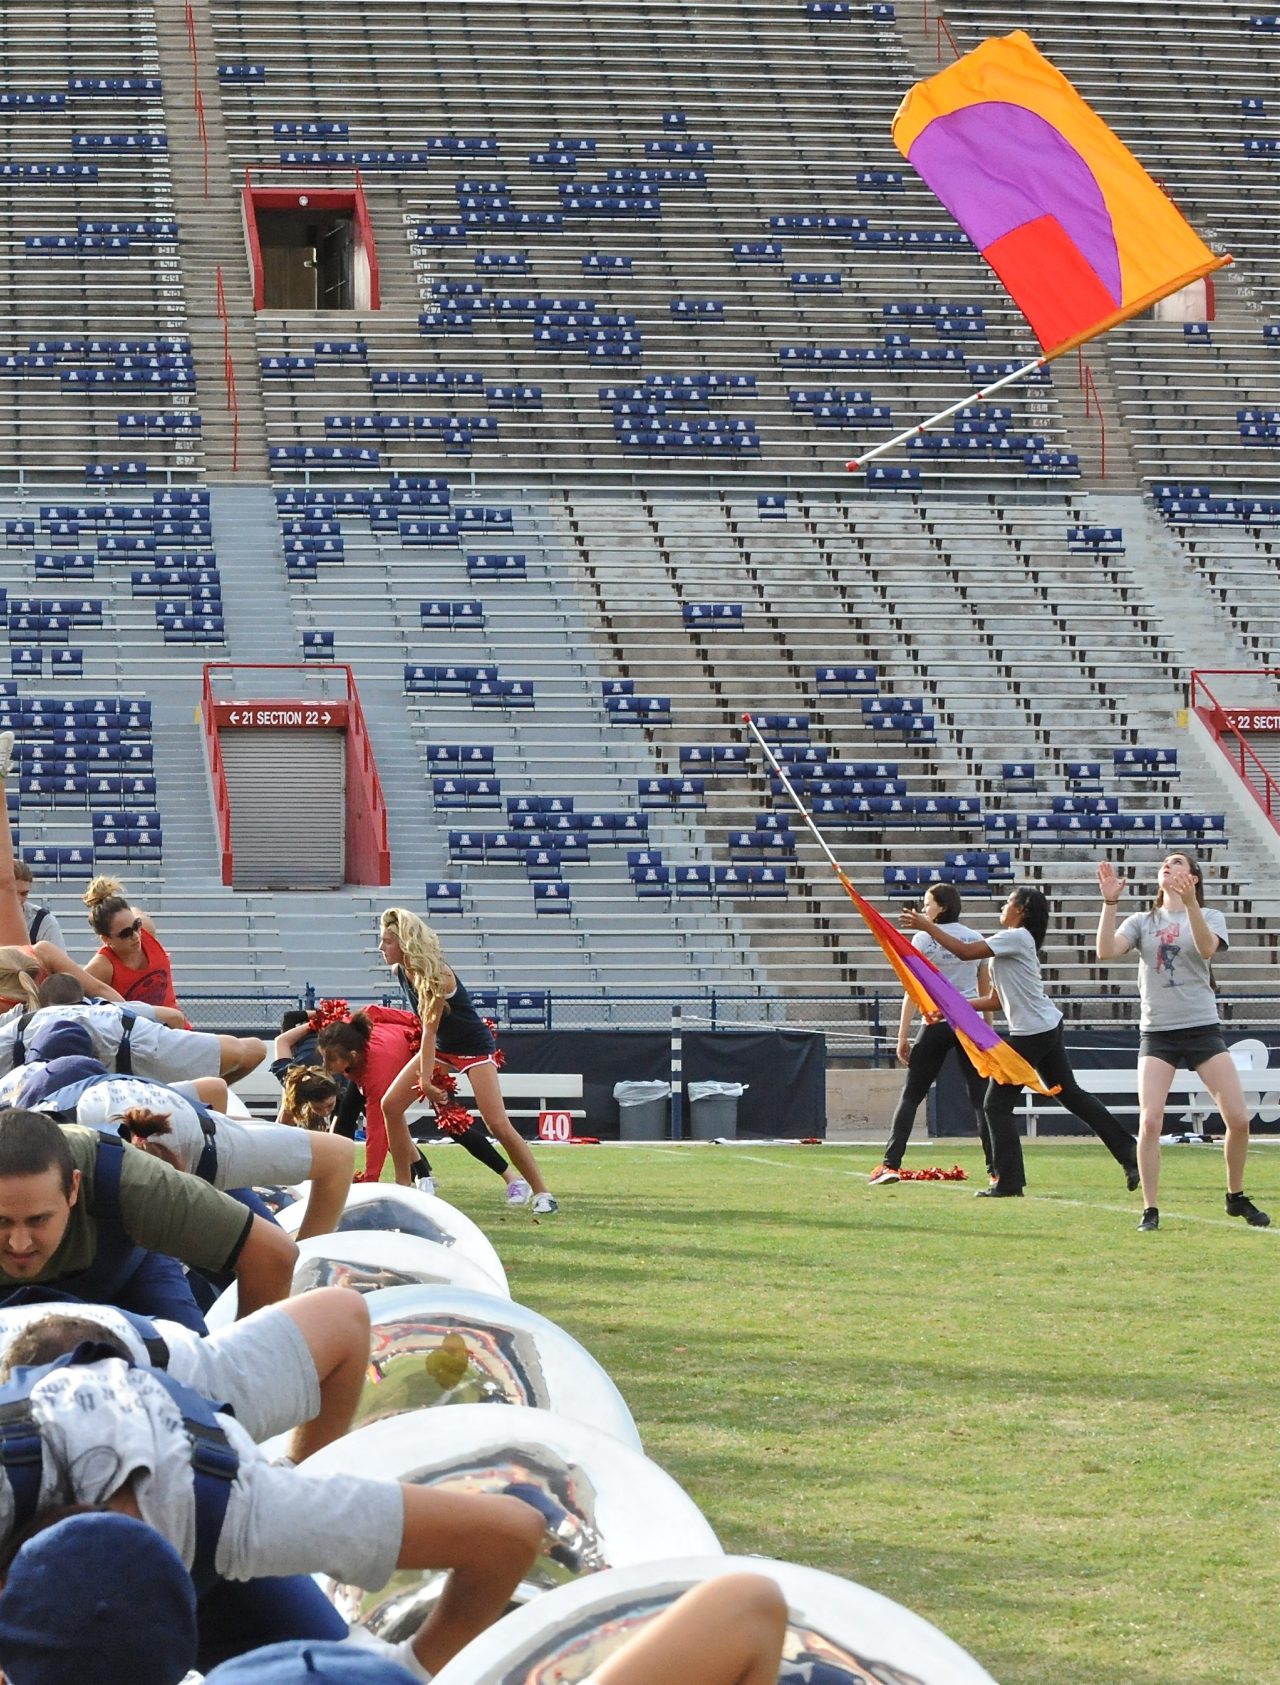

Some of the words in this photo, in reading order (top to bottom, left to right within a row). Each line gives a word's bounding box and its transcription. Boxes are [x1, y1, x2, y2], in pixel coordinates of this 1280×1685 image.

[242, 711, 253, 725] 21
[257, 711, 301, 725] SECTION
[306, 711, 318, 725] 22
[1238, 716, 1250, 728] 22
[541, 1114, 570, 1140] 40
